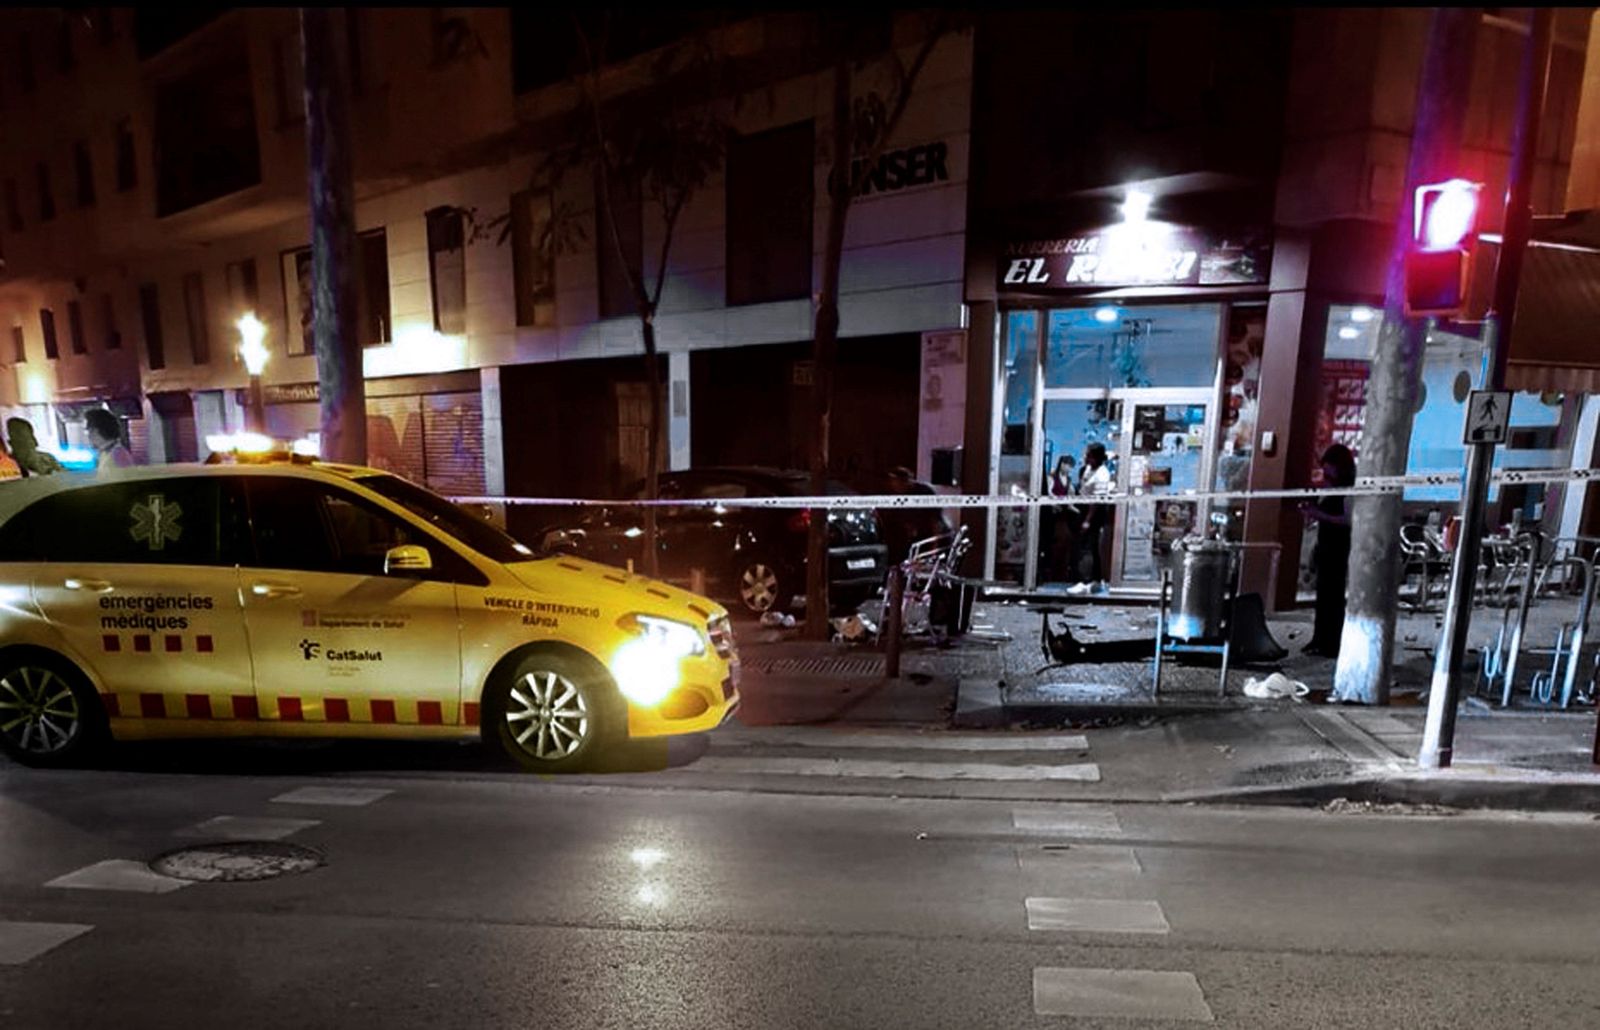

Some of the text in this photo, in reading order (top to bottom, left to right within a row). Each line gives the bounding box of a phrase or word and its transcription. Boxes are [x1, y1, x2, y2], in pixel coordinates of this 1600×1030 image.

[1004, 257, 1050, 284] EL
[484, 596, 524, 610] VEHICLE
[326, 649, 383, 661] CatSalut
